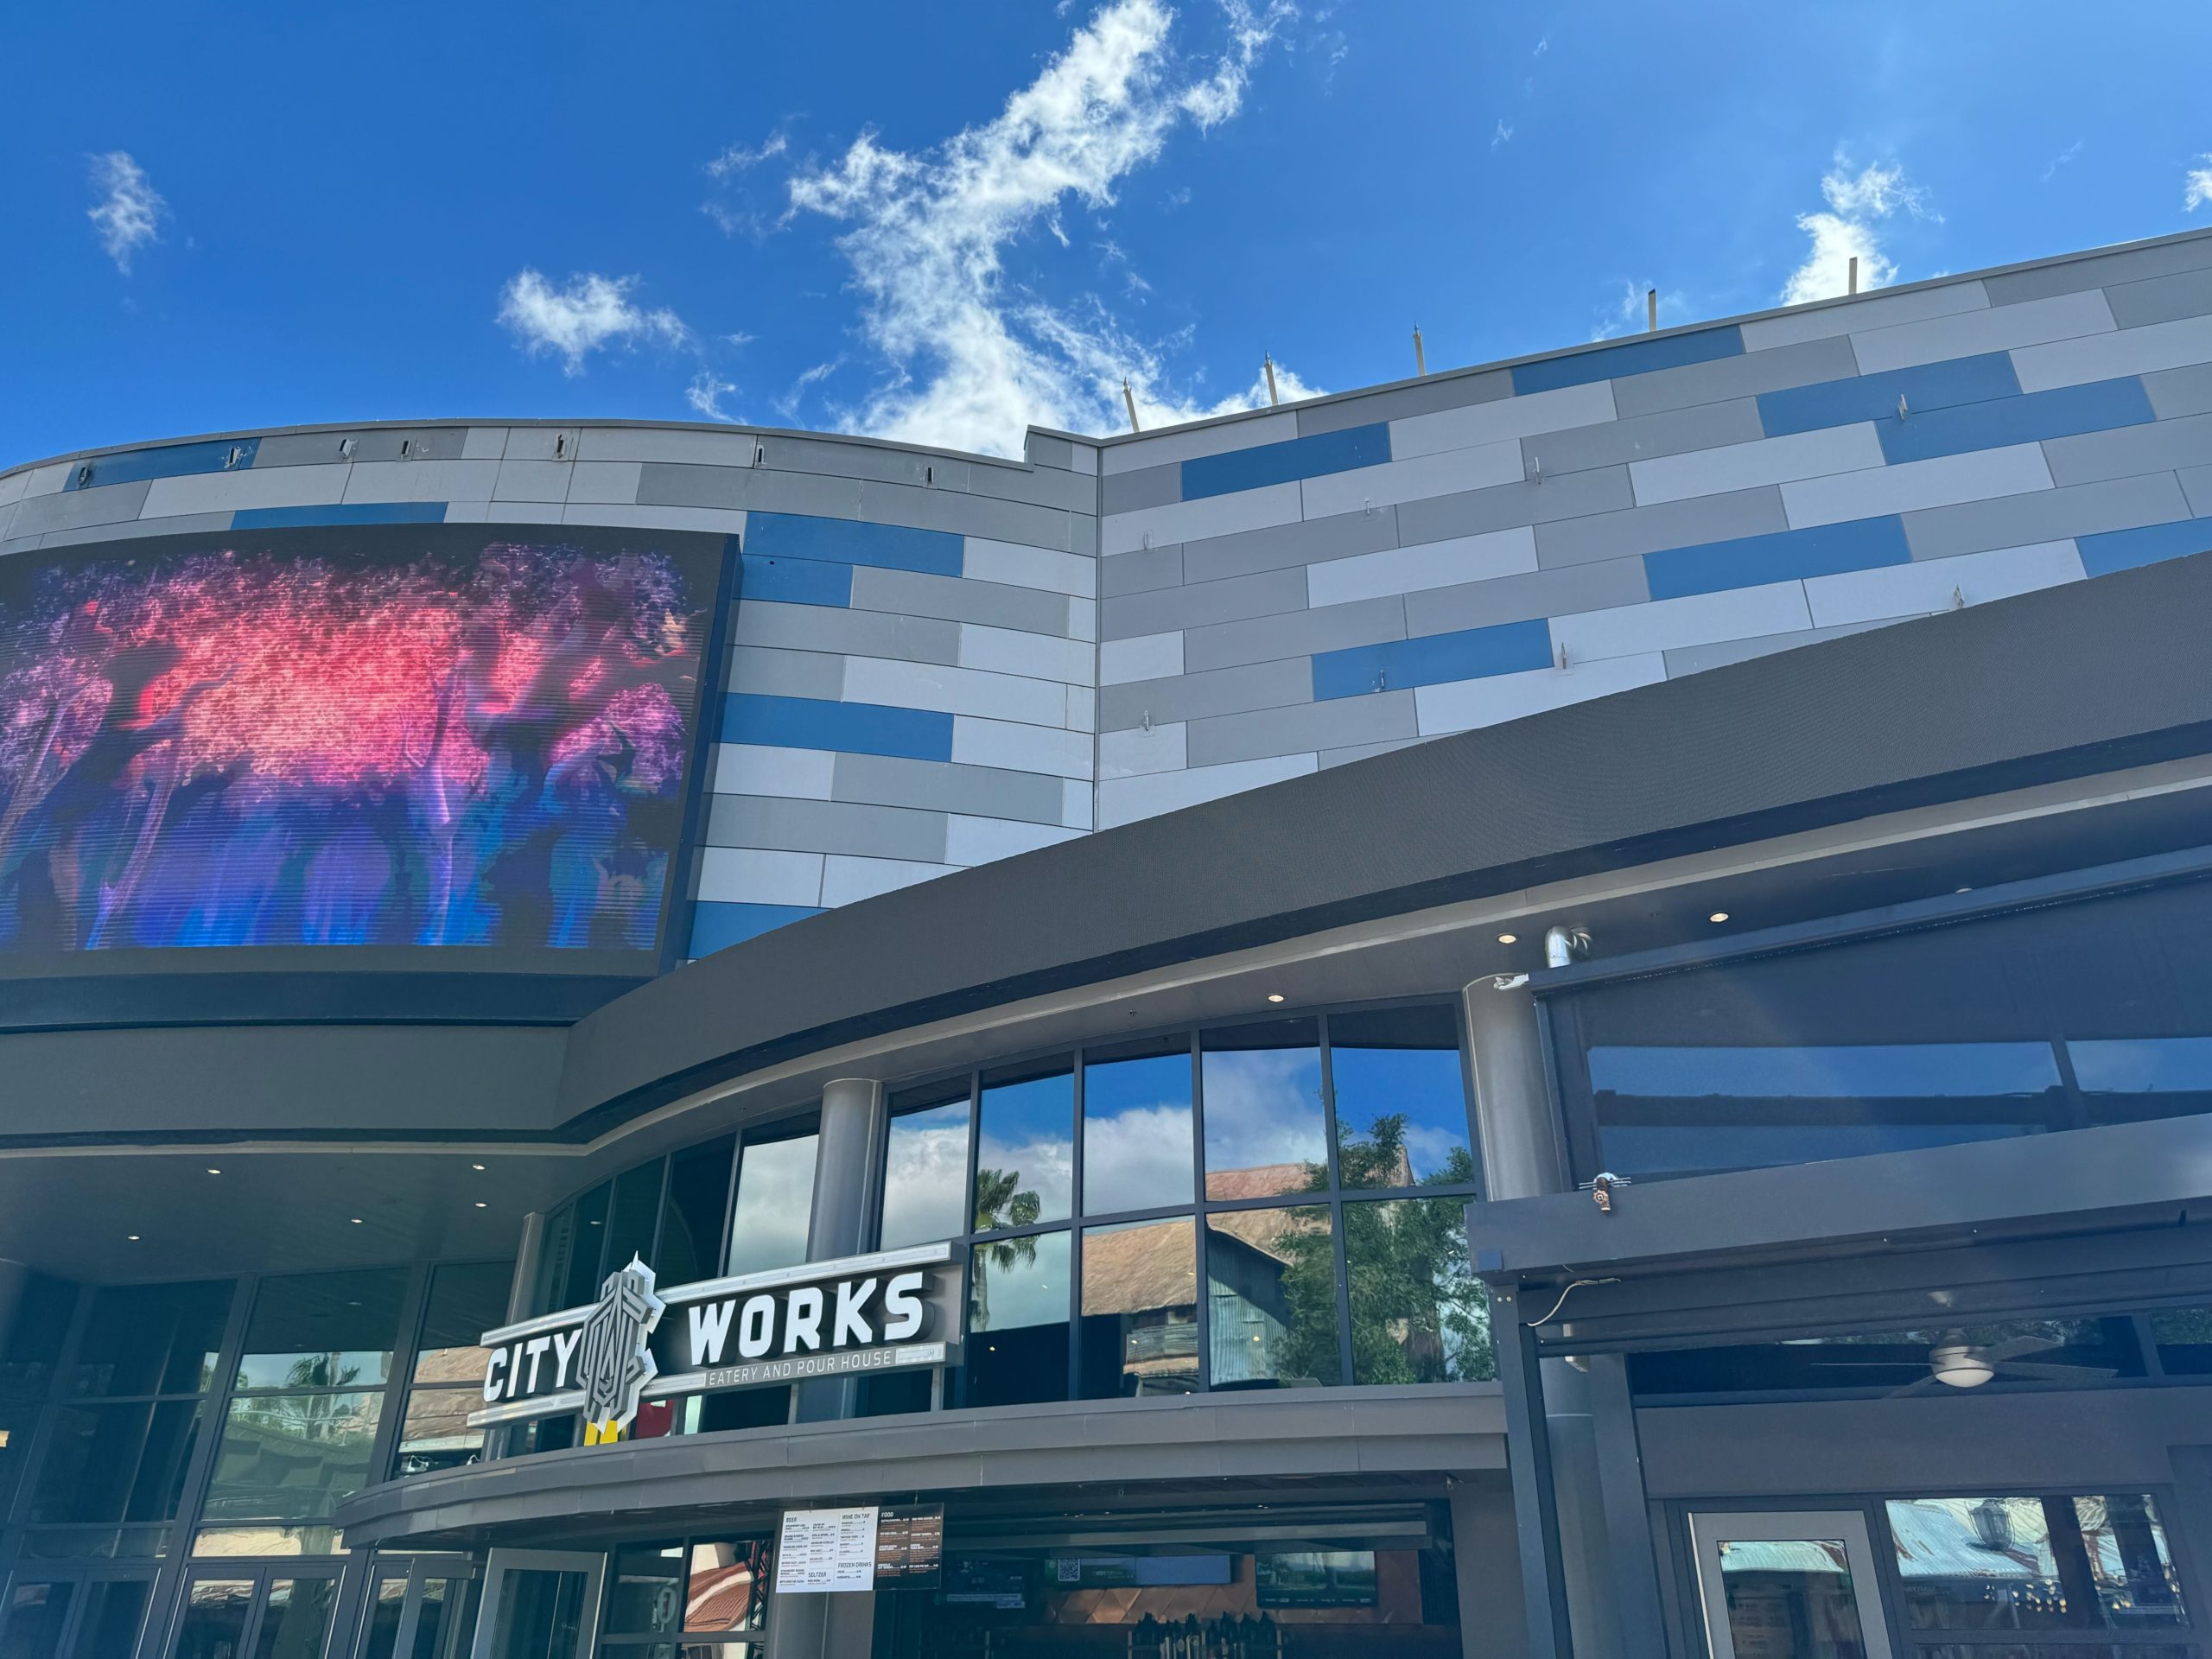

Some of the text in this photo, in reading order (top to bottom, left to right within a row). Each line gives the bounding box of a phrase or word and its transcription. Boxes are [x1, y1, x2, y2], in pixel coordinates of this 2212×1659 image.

[483, 1271, 924, 1402] CITY WORKS
[709, 1350, 892, 1386] EATERY AND POUR HOUSE
